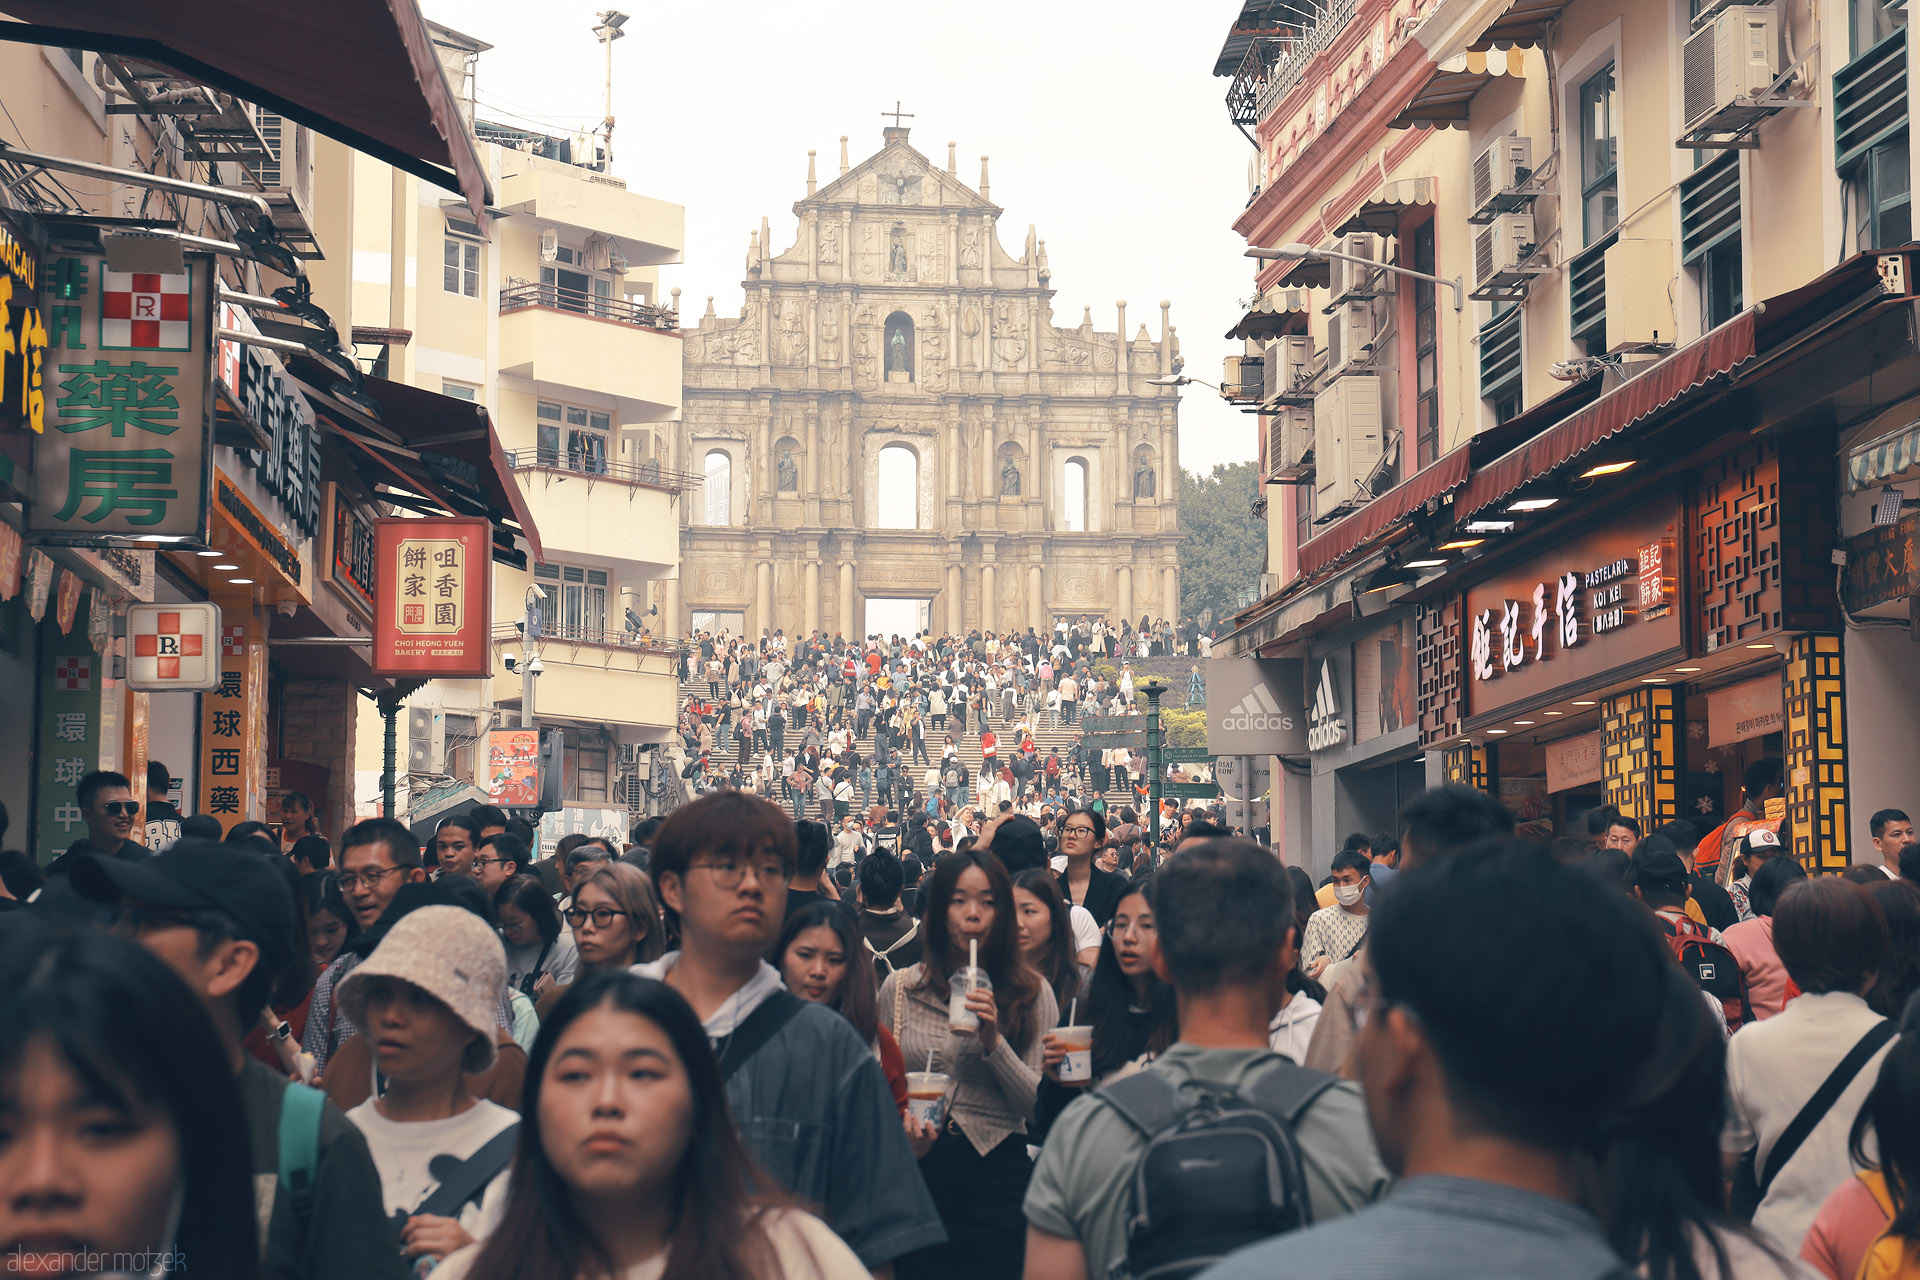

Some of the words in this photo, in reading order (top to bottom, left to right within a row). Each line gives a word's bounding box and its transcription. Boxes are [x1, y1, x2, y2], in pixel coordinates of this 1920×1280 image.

[52, 360, 180, 526] 藥房
[403, 546, 427, 598] 餅家
[434, 547, 459, 627] 咀香園
[1585, 559, 1629, 589] PASTELARIA
[1593, 590, 1606, 609] KOI
[1609, 583, 1622, 604] KEI
[1640, 576, 1662, 606] 餅家
[394, 639, 414, 647] CHOI
[415, 639, 442, 647] HEONG
[443, 639, 464, 647] YUEN
[1222, 713, 1293, 731] adidas
[1308, 716, 1342, 751] adidas
[210, 671, 243, 815] 環球西藥
[53, 713, 88, 861] 環球中
